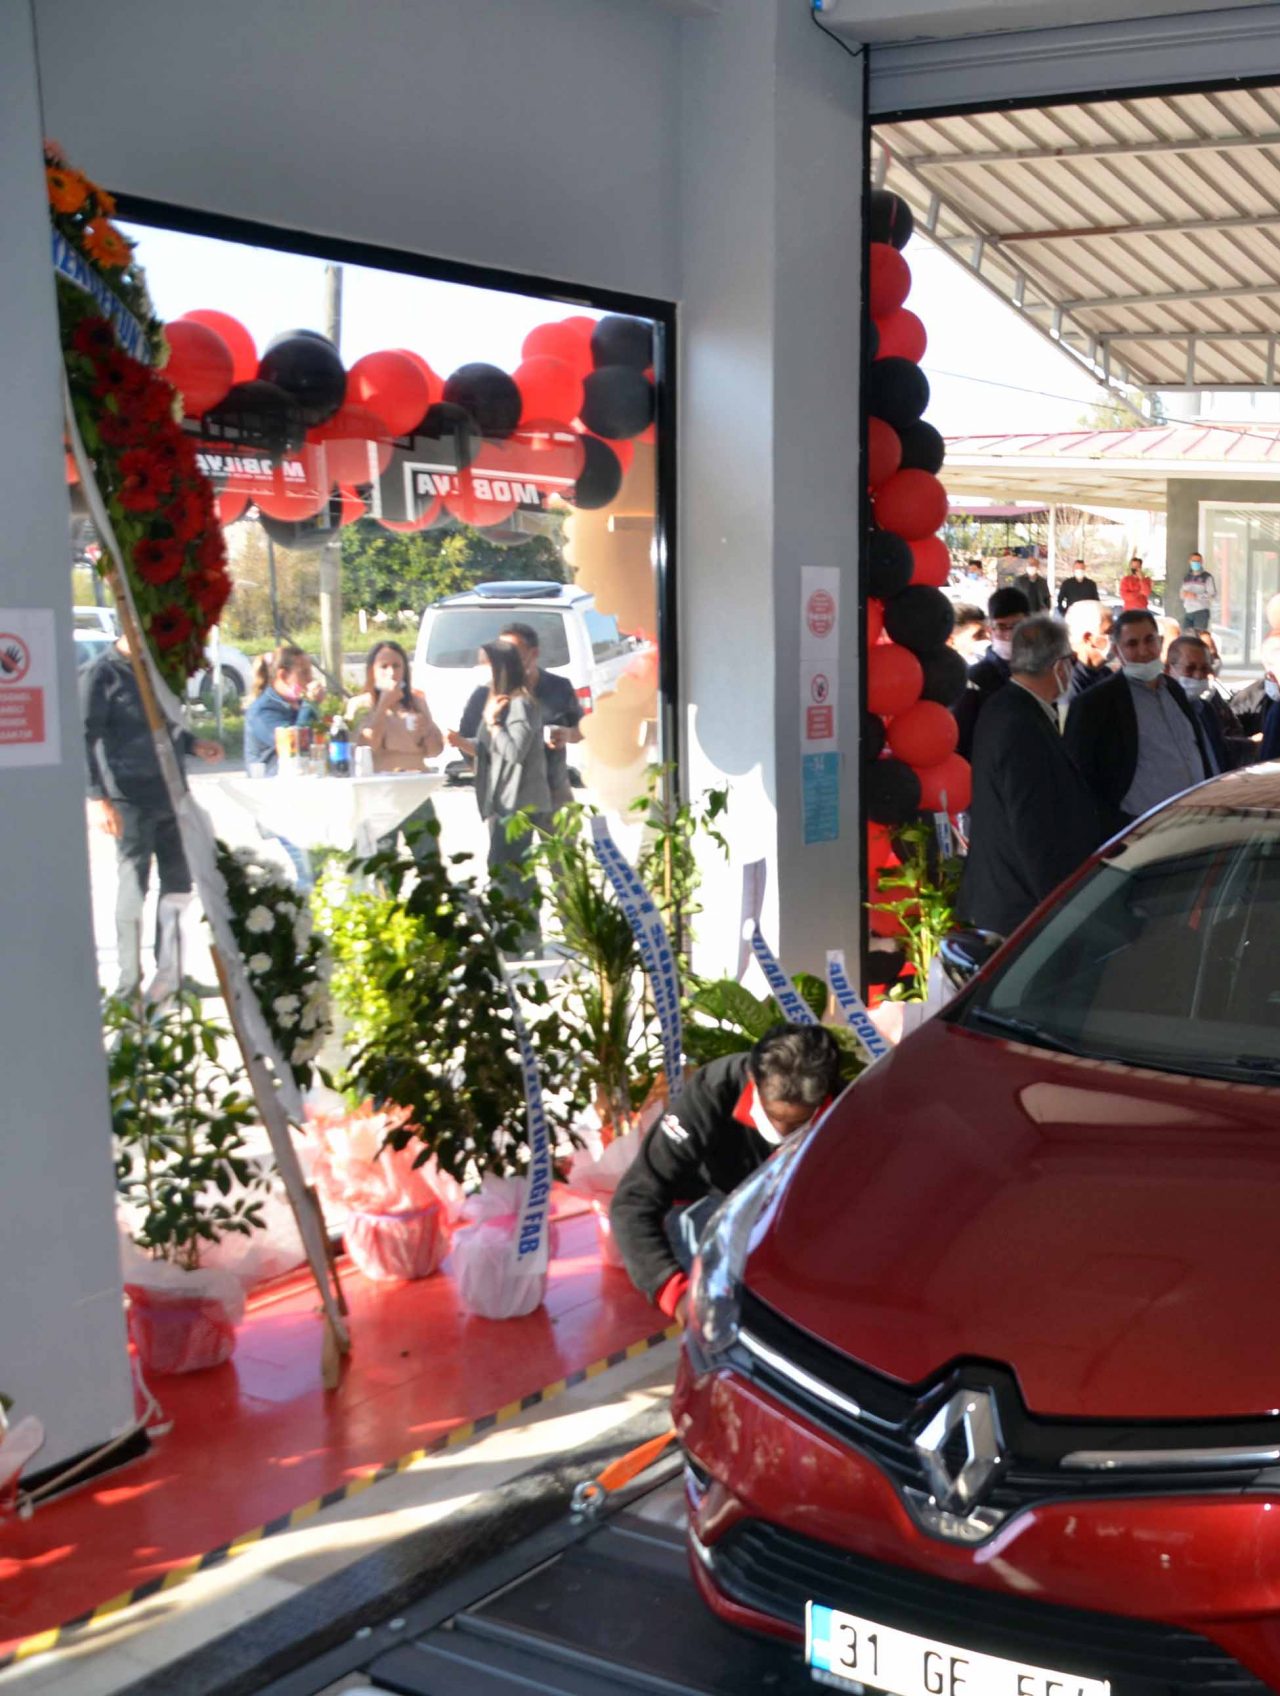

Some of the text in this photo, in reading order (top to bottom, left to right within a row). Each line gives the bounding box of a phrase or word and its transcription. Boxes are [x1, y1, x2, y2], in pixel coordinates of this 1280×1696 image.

[829, 961, 859, 1009] ADİL
[517, 1212, 543, 1262] FAB.
[839, 1623, 878, 1677] 31
